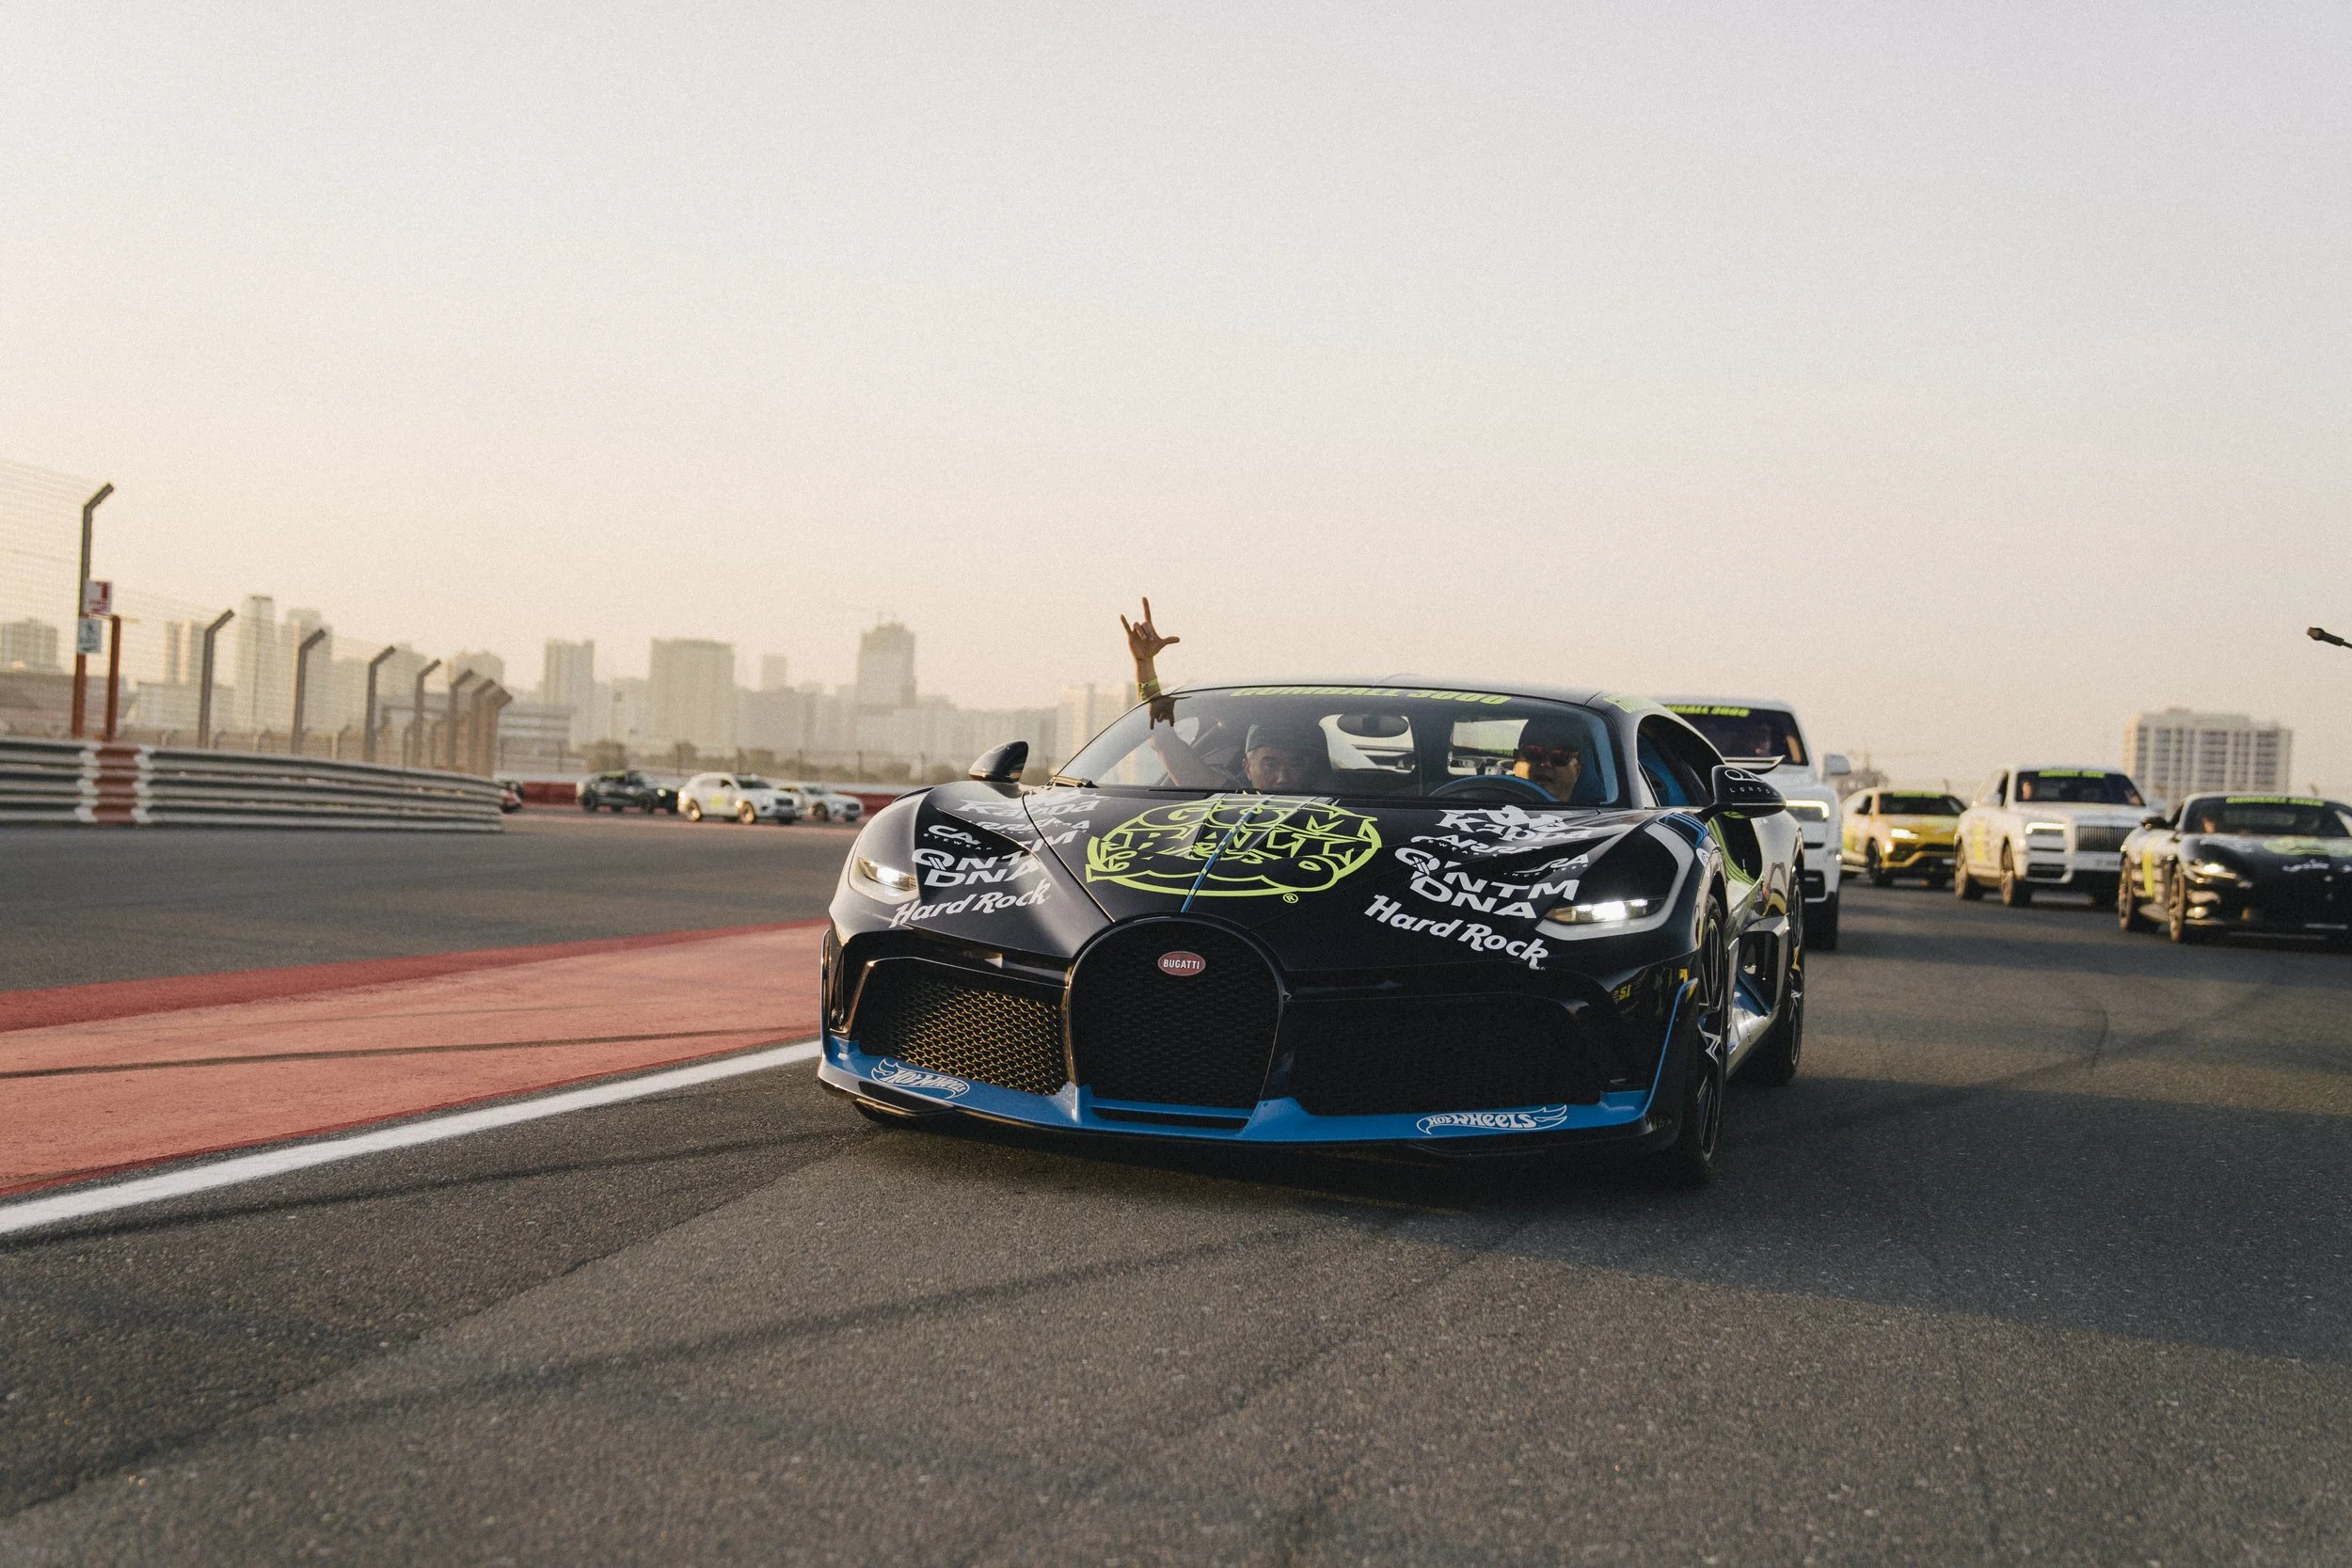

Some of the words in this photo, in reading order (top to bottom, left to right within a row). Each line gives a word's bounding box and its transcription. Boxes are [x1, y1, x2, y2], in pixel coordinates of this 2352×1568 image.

[1406, 689, 1513, 705] 3000
[1436, 811, 1592, 842] Kappa
[924, 857, 1041, 887] DNA
[1395, 847, 1580, 900] QNTM
[888, 894, 973, 929] Hard
[972, 878, 1052, 914] Rock
[1410, 871, 1537, 919] DNA
[1364, 895, 1464, 938] Hard
[1458, 923, 1549, 971] Rock
[1163, 958, 1200, 970] BUGATTI
[1426, 1115, 1454, 1127] HOT
